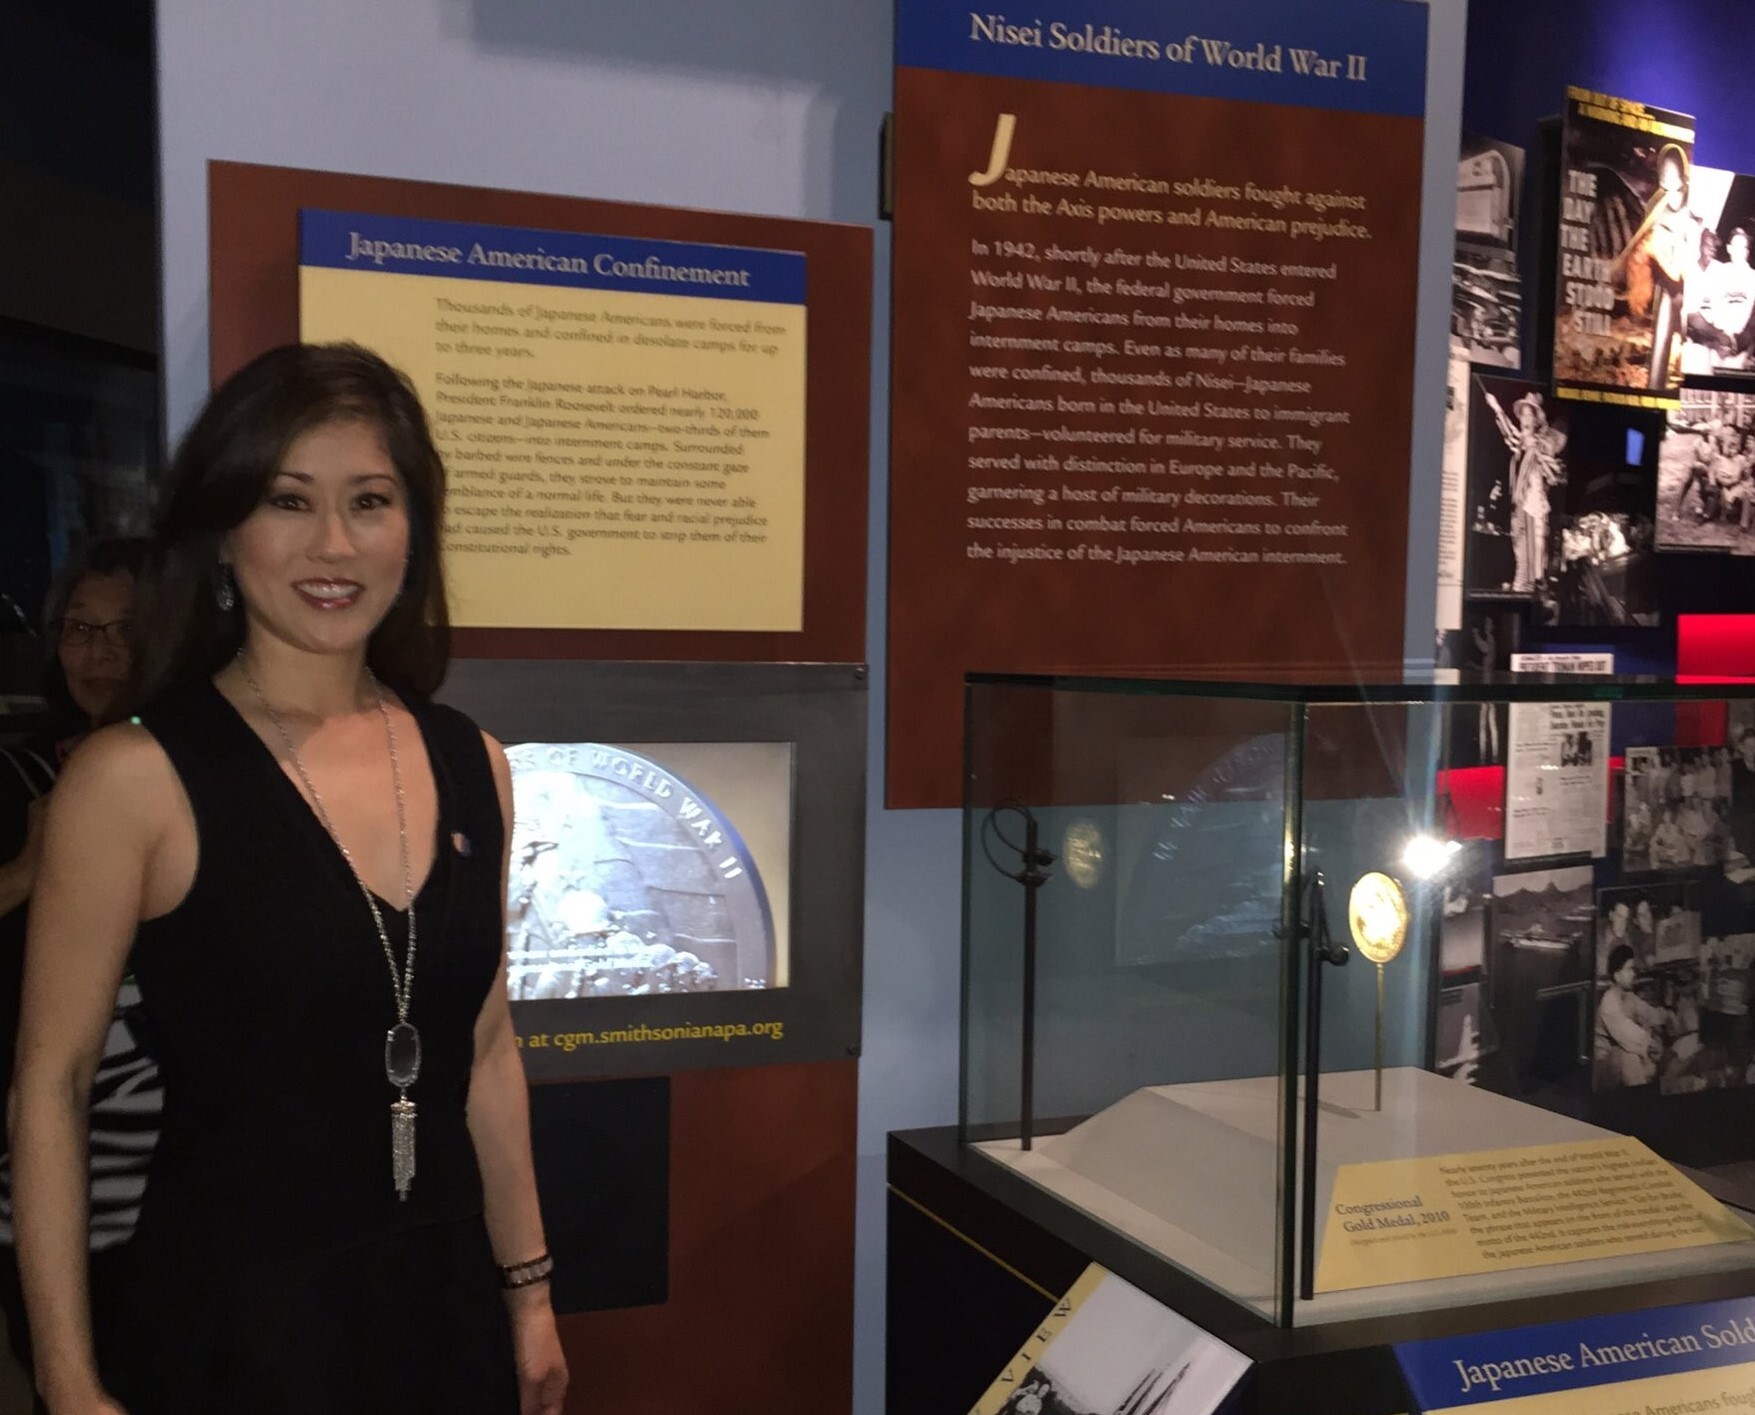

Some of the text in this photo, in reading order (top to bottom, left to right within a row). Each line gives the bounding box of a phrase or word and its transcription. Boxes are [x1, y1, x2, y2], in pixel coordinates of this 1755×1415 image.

[970, 13, 1367, 82] Nisei Soldiers of World War II
[968, 113, 1366, 211] Japanese American soldiers fought against
[972, 191, 1018, 212] both
[1021, 195, 1053, 216] the
[1055, 198, 1095, 219] Axis
[1097, 206, 1164, 224] powers
[1166, 208, 1202, 226] and
[1205, 211, 1287, 232] American
[345, 233, 751, 286] Japanese American Confinement
[971, 239, 990, 256] In
[1044, 244, 1102, 268] shortly
[1103, 248, 1142, 266] after
[1145, 251, 1172, 268] the
[1174, 254, 1228, 273] United
[1229, 256, 1278, 276] States
[1279, 263, 1338, 279] entered
[970, 270, 1024, 288] World
[1026, 274, 1062, 291] War
[1085, 277, 1113, 295] the
[1115, 278, 1171, 298] federal
[1172, 287, 1264, 304] government
[1266, 288, 1315, 307] forced
[968, 302, 1299, 335] Japanese Americans from their homes into
[969, 331, 1060, 351] internment
[1123, 340, 1162, 356] Even
[1164, 346, 1183, 358] as
[1184, 347, 1229, 364] many
[1229, 344, 1249, 361] of
[1250, 346, 1286, 363] their
[1288, 348, 1346, 366] families
[968, 366, 1009, 379] were
[1090, 368, 1173, 387] thousands
[1174, 371, 1193, 388] of
[968, 393, 1350, 427] Americans born in the United States to immigrant
[1138, 428, 1163, 445] for
[1165, 430, 1225, 451] military
[1288, 434, 1322, 454] They
[967, 454, 1021, 470] served
[1023, 454, 1060, 471] with
[1062, 456, 1148, 473] distinction
[1149, 458, 1166, 474] in
[1168, 459, 1224, 480] Europe
[1227, 462, 1257, 477] and
[1259, 462, 1284, 478] the
[966, 485, 1046, 506] garnering
[1047, 489, 1059, 501] a
[1061, 484, 1098, 502] host
[1100, 486, 1119, 502] of
[1121, 487, 1182, 508] military
[1282, 491, 1319, 507] Their
[966, 514, 1348, 536] successes in combat forced Americans to confront
[966, 542, 994, 558] the
[996, 543, 1064, 564] injustice
[1066, 543, 1085, 560] of
[1087, 544, 1114, 561] the
[1114, 547, 1185, 565] Japanese
[1187, 547, 1260, 562] American
[529, 1032, 549, 1048] at
[554, 1021, 784, 1052] cgm.smithsonianapa.org
[1335, 1194, 1424, 1216] Congressional
[1342, 1217, 1376, 1233] Gold
[1420, 1210, 1451, 1224] 2010
[1452, 1352, 1575, 1393] Japanese
[1580, 1332, 1703, 1369] American
